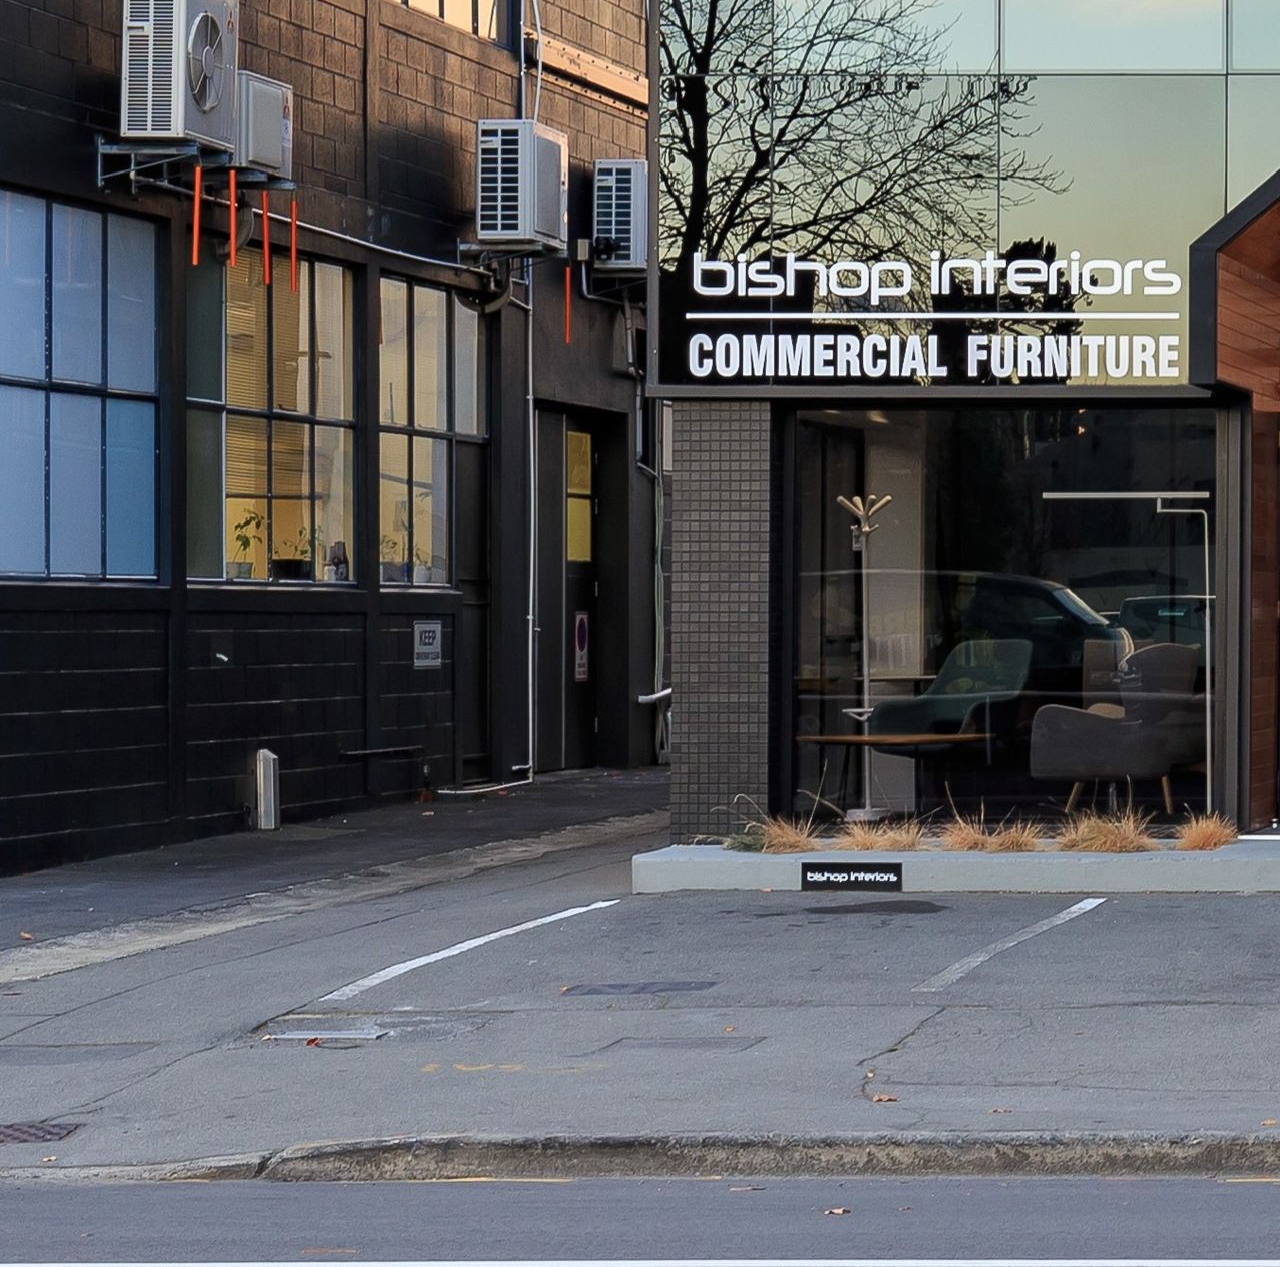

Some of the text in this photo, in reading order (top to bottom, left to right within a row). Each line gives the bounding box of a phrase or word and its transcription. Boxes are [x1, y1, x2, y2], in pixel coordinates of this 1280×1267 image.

[692, 250, 1182, 306] bishop interiors
[688, 334, 1180, 378] COMMERCIAL FURNITURE
[419, 630, 437, 646] KEEP
[806, 871, 848, 883] bishop
